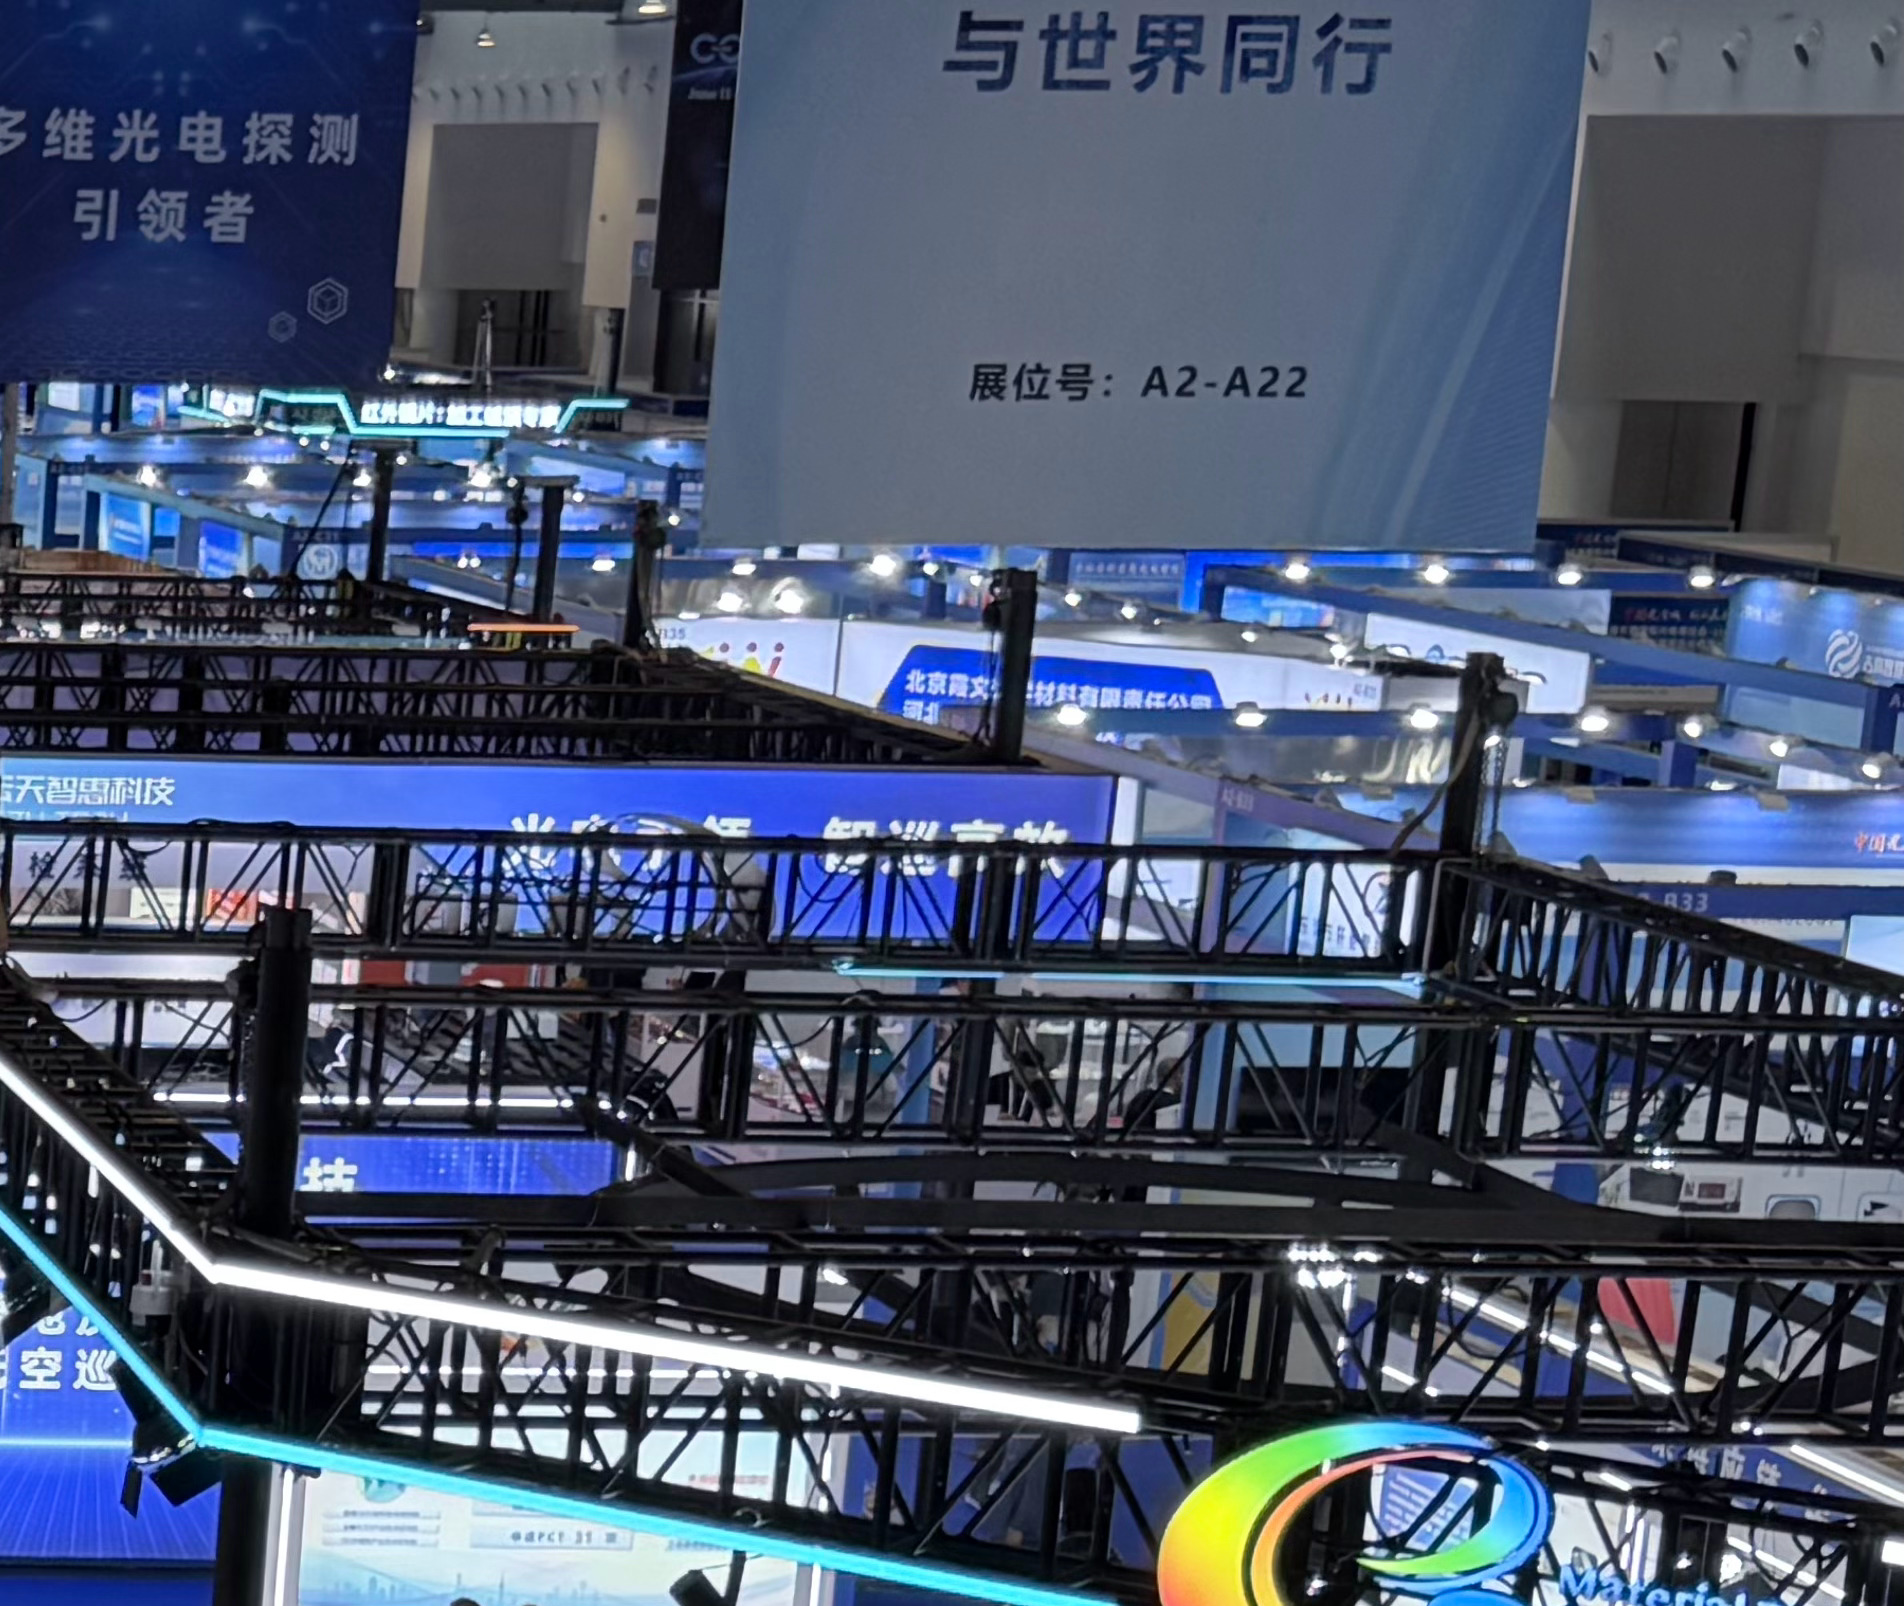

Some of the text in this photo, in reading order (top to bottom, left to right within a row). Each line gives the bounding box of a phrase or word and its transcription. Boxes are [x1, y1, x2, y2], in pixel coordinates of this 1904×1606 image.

[942, 11, 1392, 96] 与世界同行
[75, 189, 253, 244] 引领者
[1141, 367, 1310, 401] A2-A22
